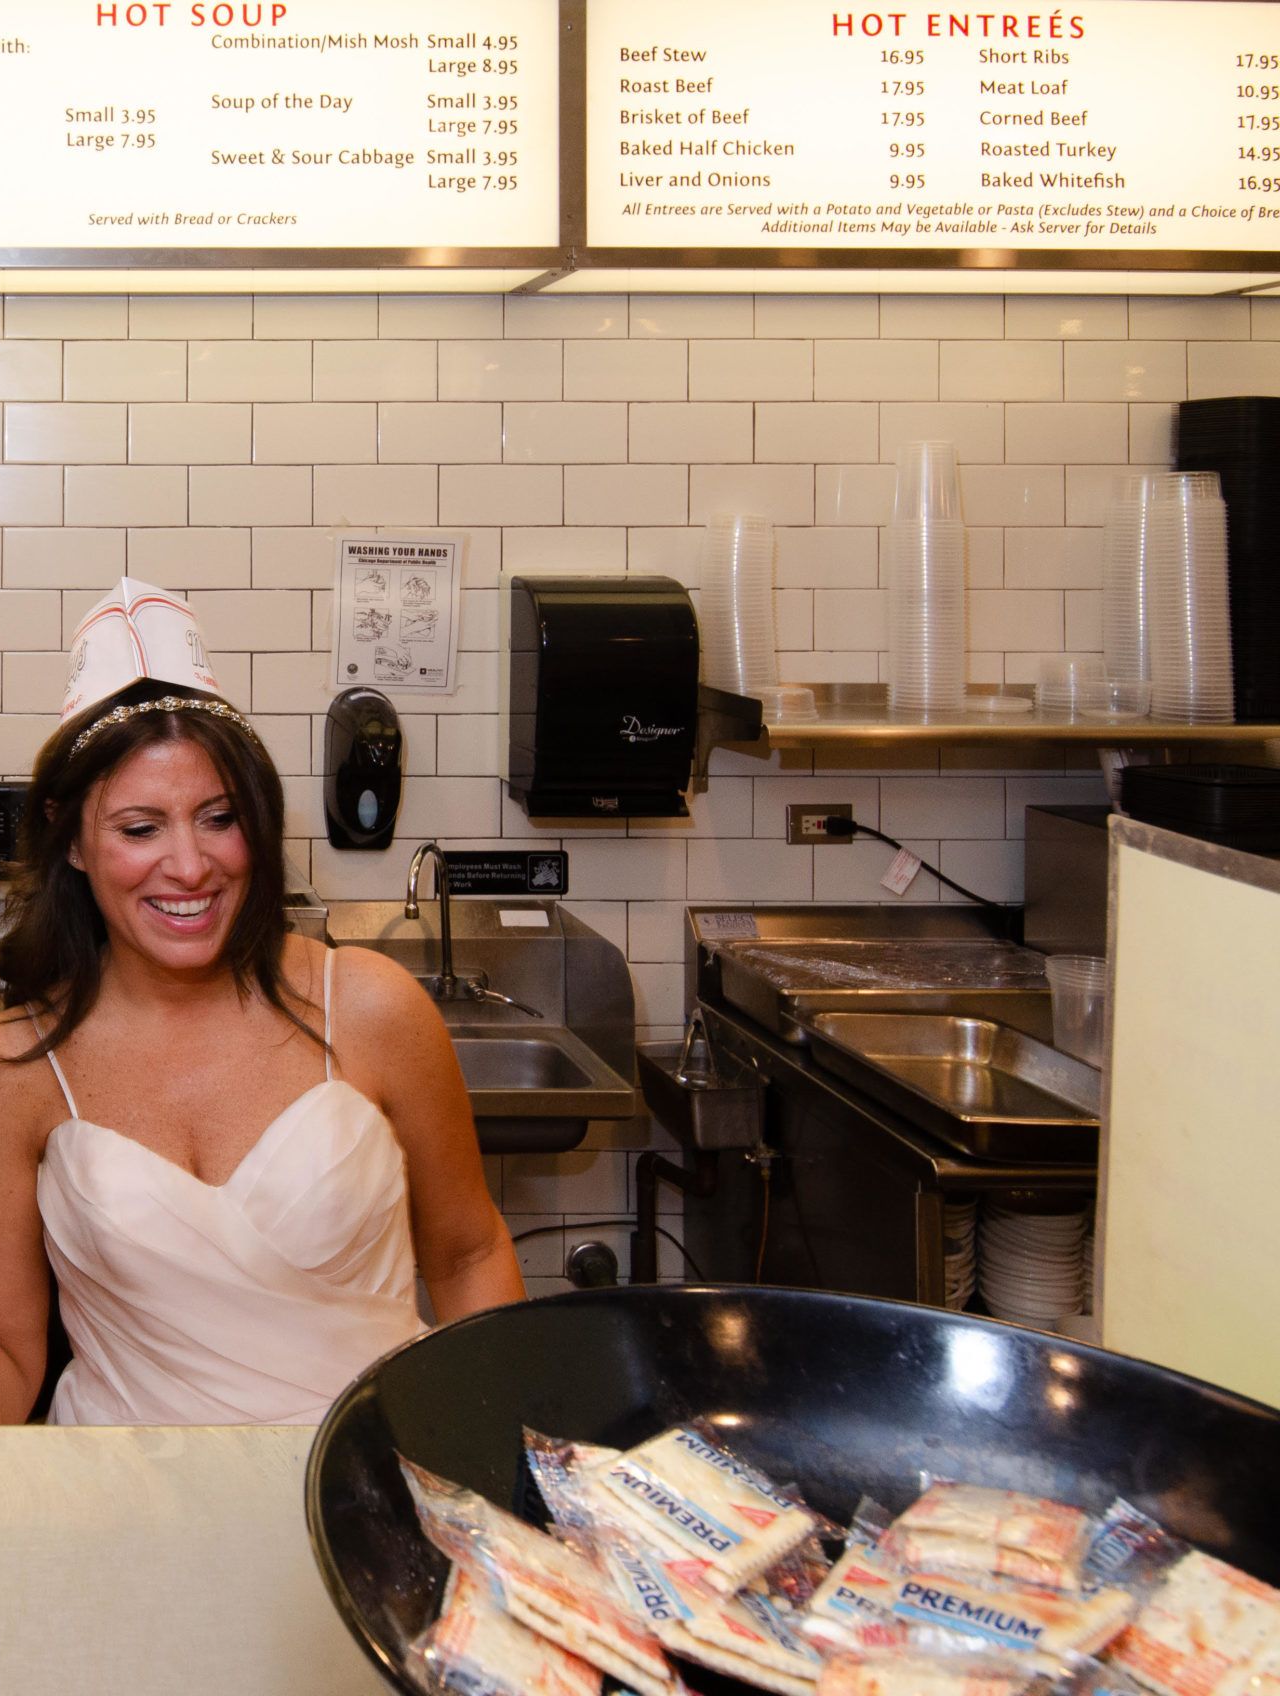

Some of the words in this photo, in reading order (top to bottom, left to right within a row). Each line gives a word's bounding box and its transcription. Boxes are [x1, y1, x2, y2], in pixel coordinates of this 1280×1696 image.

[97, 2, 171, 26] HOT
[191, 2, 287, 27] SOUP
[833, 13, 907, 36] HOT
[928, 9, 1084, 39] ENTREÉS
[212, 33, 367, 53] Combination/Mish
[374, 33, 418, 48] Mosh
[427, 33, 476, 48] Small
[483, 36, 517, 50] 4.95
[621, 46, 658, 61] Beef
[664, 48, 707, 62] Stew
[881, 50, 924, 64] 16.95
[980, 48, 1028, 63] Short
[1034, 48, 1070, 64] Ribs
[1237, 53, 1280, 69] 17.95
[429, 59, 477, 77] Large
[483, 58, 517, 74] 8.95
[621, 79, 669, 93] Roast
[676, 77, 714, 93] Beef
[882, 81, 925, 96] 17.95
[981, 80, 1025, 94] Meat
[1031, 79, 1068, 95] Loaf
[1237, 85, 1280, 100] 10.95
[212, 94, 255, 113] Soup
[285, 93, 313, 109] the
[320, 94, 352, 113] Day
[427, 92, 476, 108] Small
[483, 96, 517, 110] 3.95
[65, 106, 113, 122] Small
[122, 109, 155, 124] 3.95
[620, 108, 682, 124] Brisket
[712, 108, 749, 124] Beef
[882, 112, 925, 126] 17.95
[980, 110, 1044, 125] Corned
[1051, 110, 1088, 126] Beef
[1238, 114, 1280, 130] 17.95
[429, 118, 476, 137] Large
[483, 120, 517, 134] 7.95
[67, 132, 114, 151] Large
[121, 133, 155, 148] 7.95
[620, 140, 672, 155] Baked
[680, 139, 718, 155] Half
[723, 140, 794, 155] Chicken
[212, 150, 265, 164] Sweet
[292, 150, 333, 164] Sour
[338, 148, 414, 169] Cabbage
[427, 148, 476, 164] Small
[483, 151, 517, 166] 3.95
[890, 143, 925, 158] 9.95
[981, 141, 1050, 156] Roasted
[1056, 141, 1117, 161] Turkey
[1239, 146, 1280, 161] 14.95
[429, 174, 476, 193] Large
[483, 176, 517, 190] 7.95
[620, 172, 663, 187] Liver
[669, 171, 702, 187] and
[708, 172, 771, 187] Onions
[890, 174, 926, 189] 9.95
[982, 172, 1033, 187] Baked
[1040, 172, 1126, 188] Whitefish
[89, 213, 133, 225] Served
[138, 212, 169, 225] with
[175, 212, 214, 225] Bread
[237, 212, 297, 224] Crackers
[622, 202, 641, 215] All
[645, 204, 696, 215] Entrees
[701, 206, 723, 215] are
[728, 203, 773, 215] Served
[777, 202, 808, 215] with
[826, 203, 871, 215] Potato
[876, 202, 902, 215] and
[907, 203, 974, 219] Vegetable
[997, 204, 1034, 221] Pasta
[1039, 203, 1102, 218] (Excludes
[1107, 205, 1145, 220] Stew)
[1149, 204, 1175, 217] and
[1192, 205, 1236, 218] Choice
[761, 220, 834, 232] Additional
[838, 221, 876, 232] Items
[881, 221, 911, 236] May
[935, 220, 997, 233] Available
[1010, 220, 1034, 233] Ask
[1038, 221, 1081, 233] Server
[1084, 220, 1105, 237] for
[1110, 222, 1157, 234] Details
[348, 546, 389, 555] WASHING
[392, 547, 415, 556] YOUR
[418, 548, 448, 557] HANDS
[448, 863, 482, 871] mployees
[491, 872, 526, 881] Returning
[610, 1465, 733, 1552] PREMIUM
[900, 1582, 1044, 1641] PREMIUM
